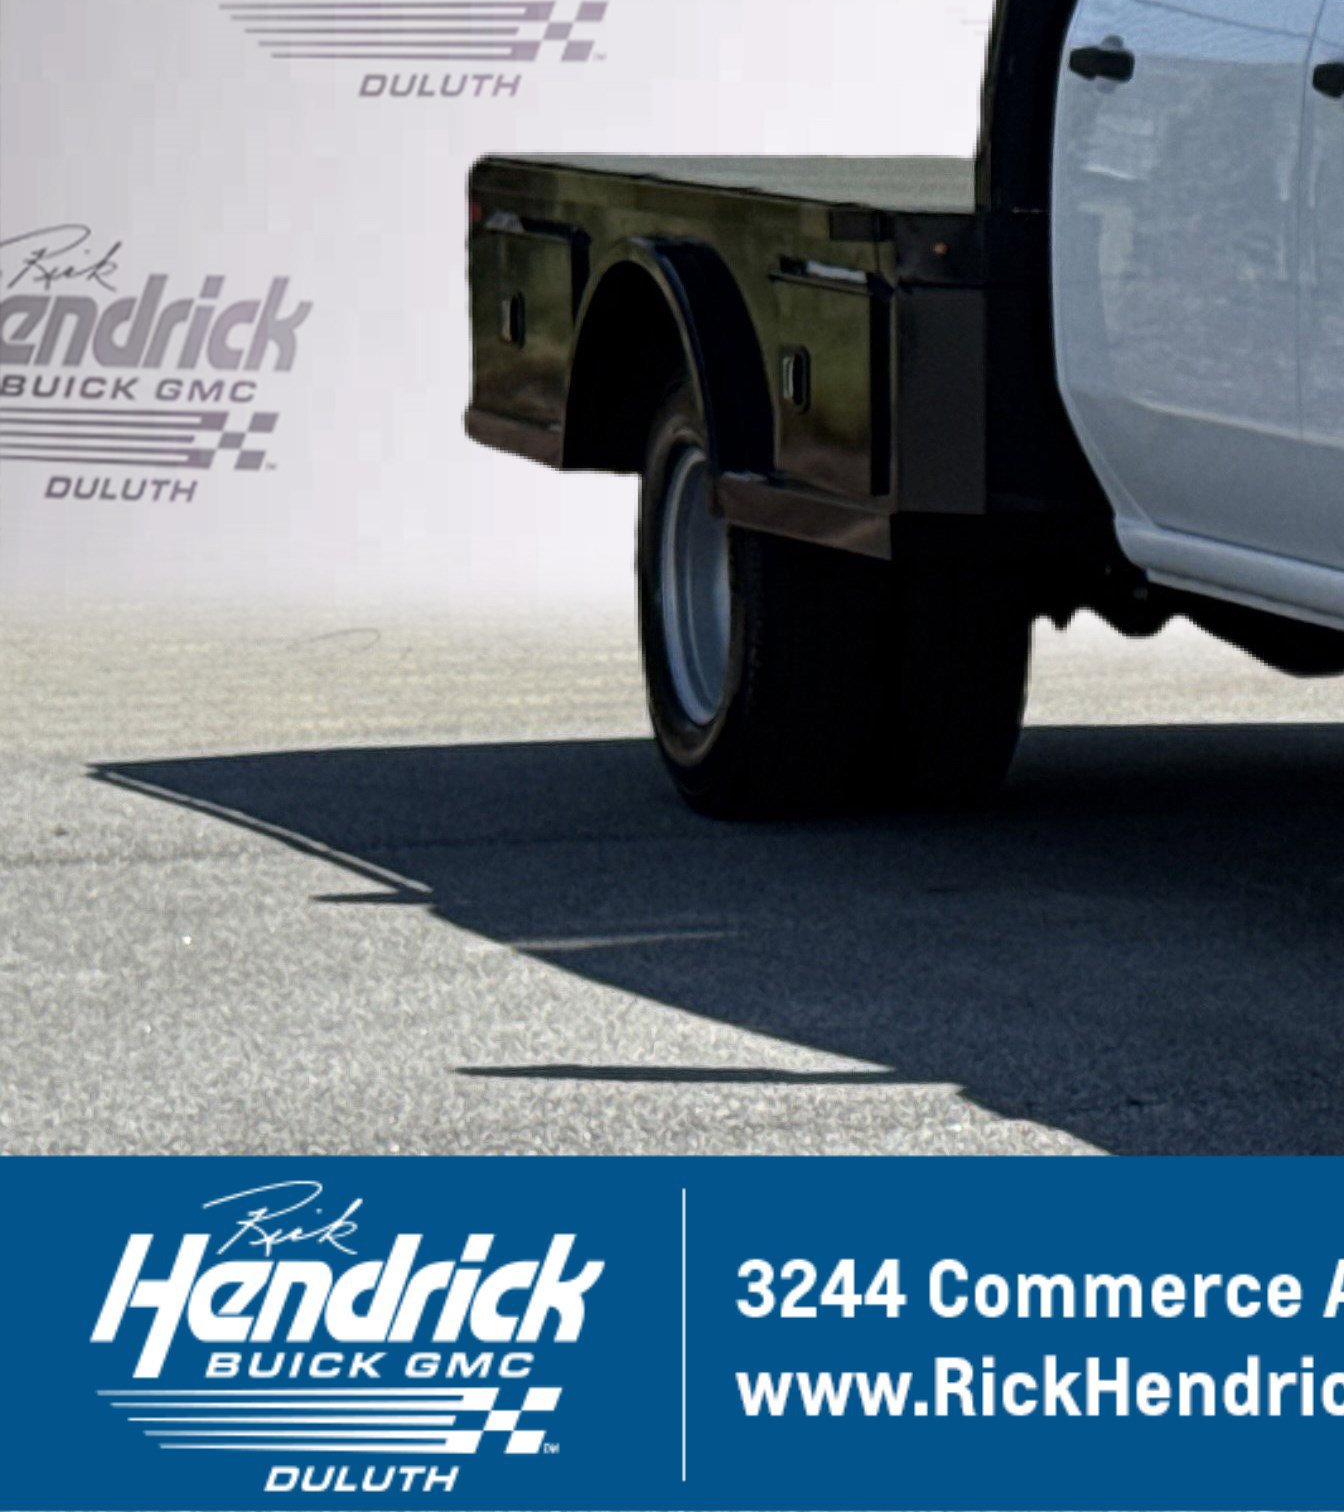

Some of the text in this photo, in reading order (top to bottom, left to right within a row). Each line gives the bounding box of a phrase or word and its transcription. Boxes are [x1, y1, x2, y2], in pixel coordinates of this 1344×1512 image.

[358, 74, 521, 98] DULUTH
[1, 374, 257, 403] BUICK GMC
[44, 476, 198, 502] DULUTH
